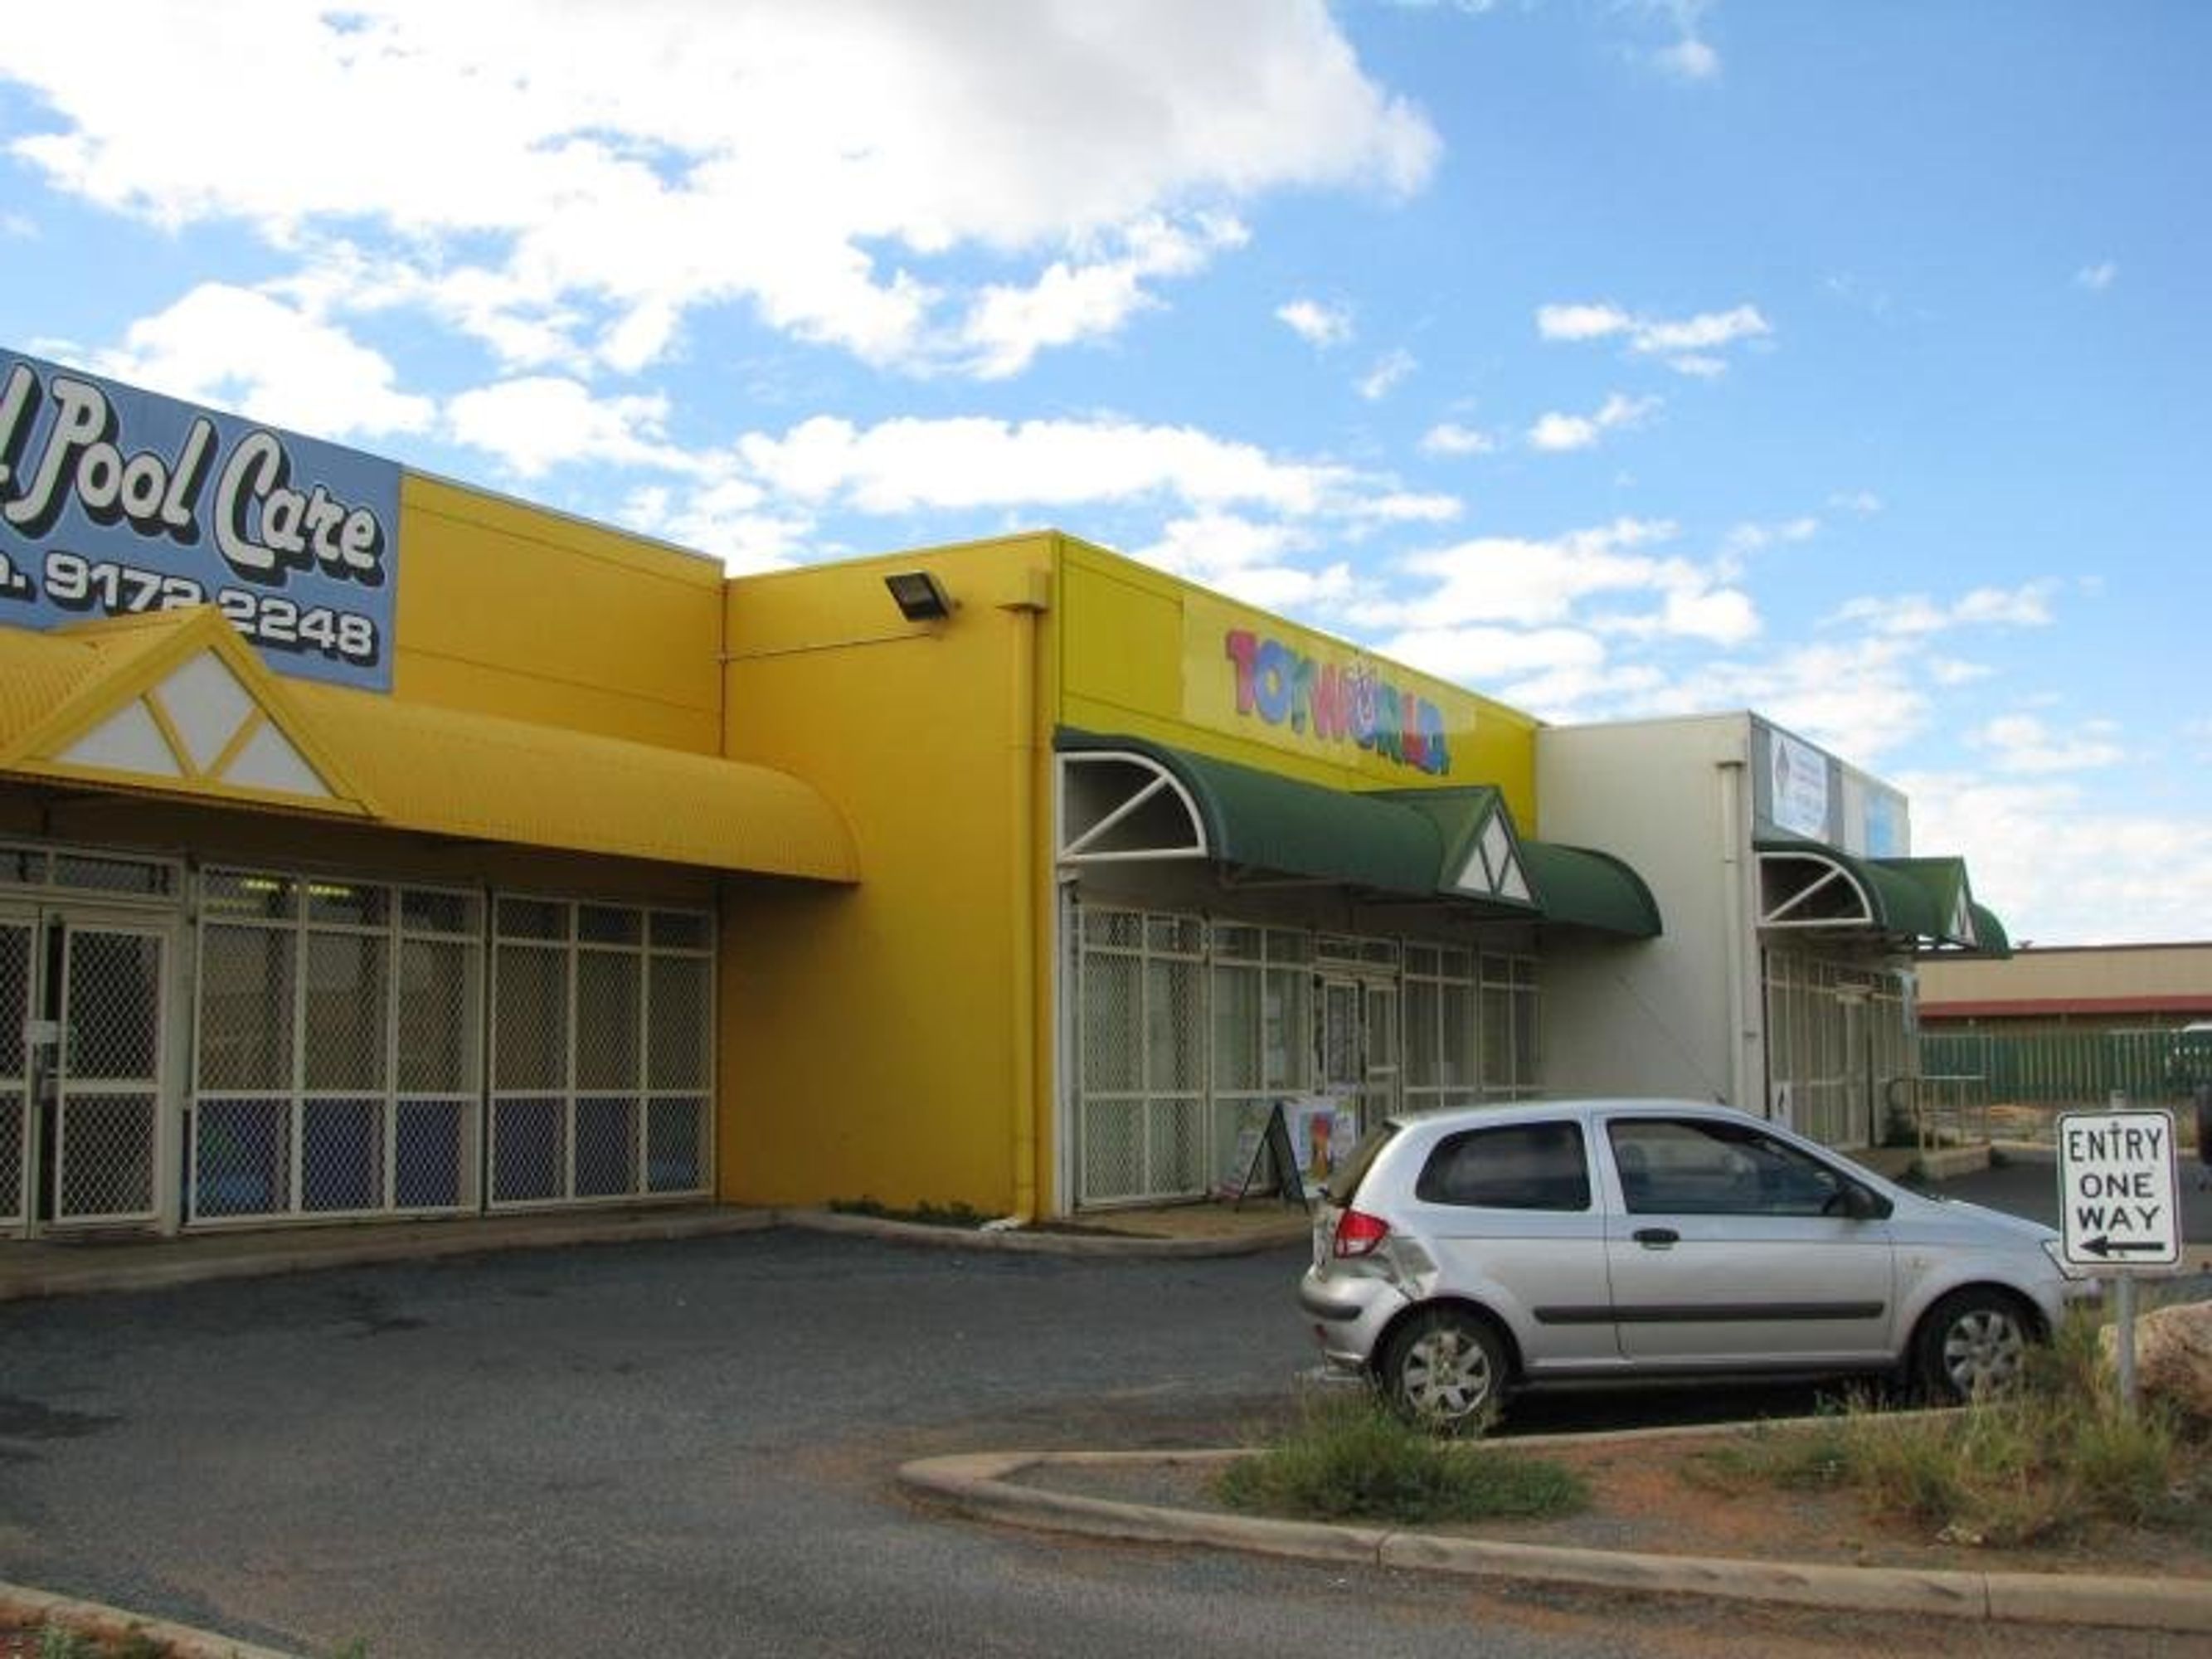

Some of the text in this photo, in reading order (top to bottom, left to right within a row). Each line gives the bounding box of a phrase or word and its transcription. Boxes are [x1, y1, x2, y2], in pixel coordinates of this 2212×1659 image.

[3, 376, 215, 533] Pool
[215, 430, 380, 574] Care
[217, 588, 375, 659] 2248
[2069, 1128, 2162, 1162] ENTRY
[2080, 1173, 2154, 1199] ONE
[2077, 1205, 2161, 1231] WAY
